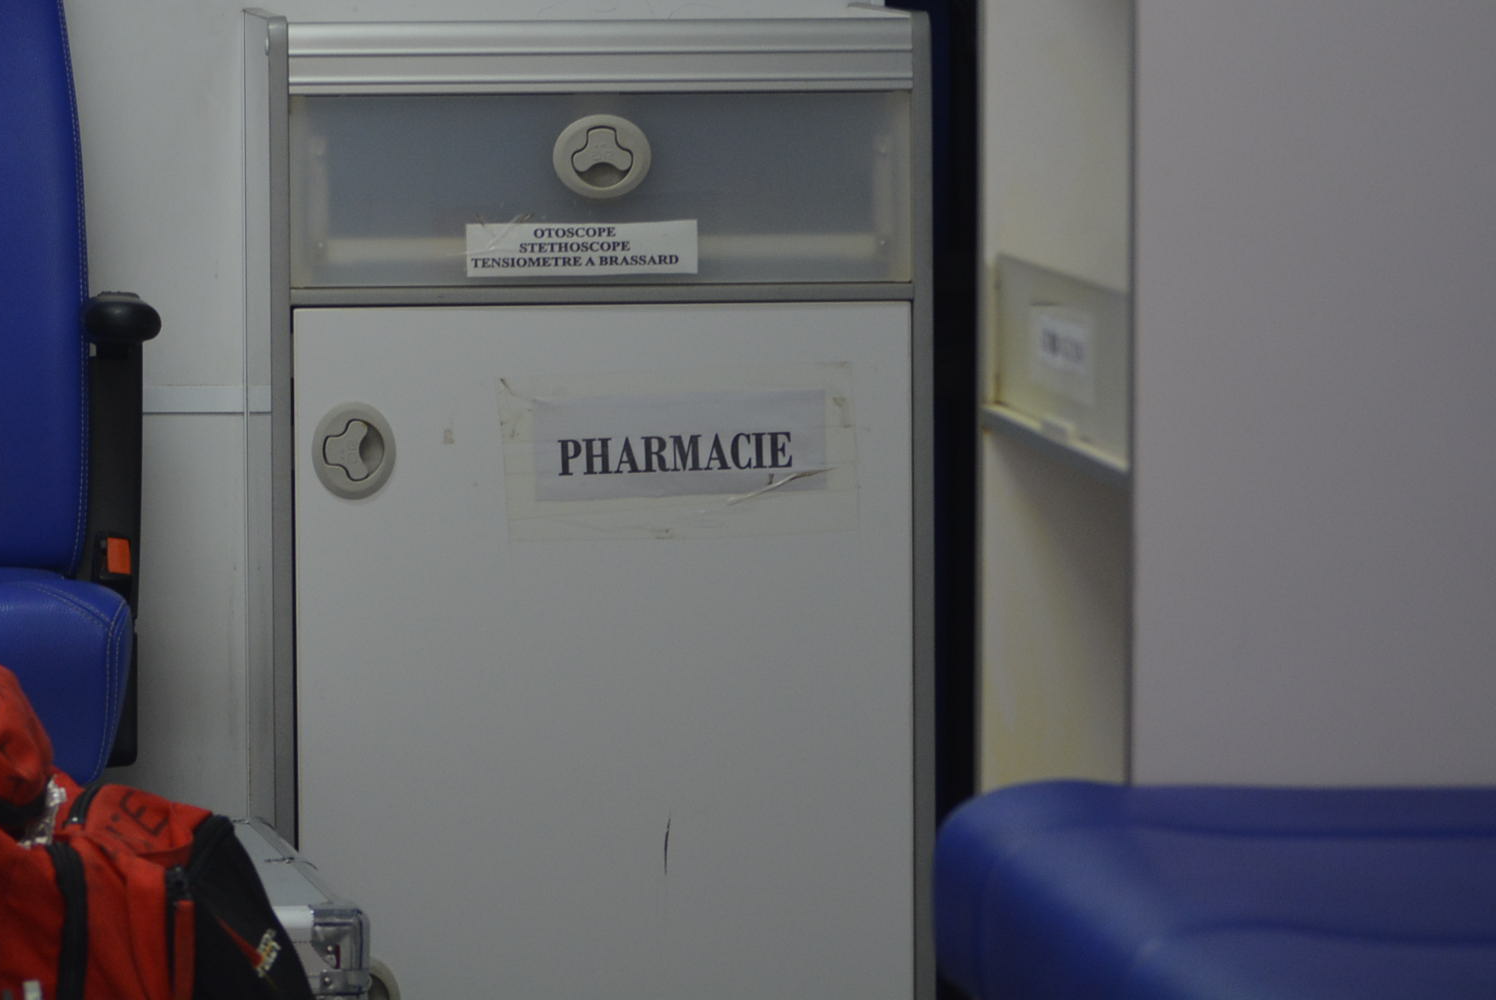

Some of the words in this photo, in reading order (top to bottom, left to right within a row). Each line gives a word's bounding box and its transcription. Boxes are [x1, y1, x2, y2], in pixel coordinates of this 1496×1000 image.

[533, 226, 616, 239] OTOSCOPE
[519, 240, 631, 253] STETHOSCOPE
[471, 256, 583, 269] TENSIOMETRE
[585, 256, 597, 267] A
[599, 254, 679, 267] BRASSARD
[558, 431, 793, 476] PHARMACIE
